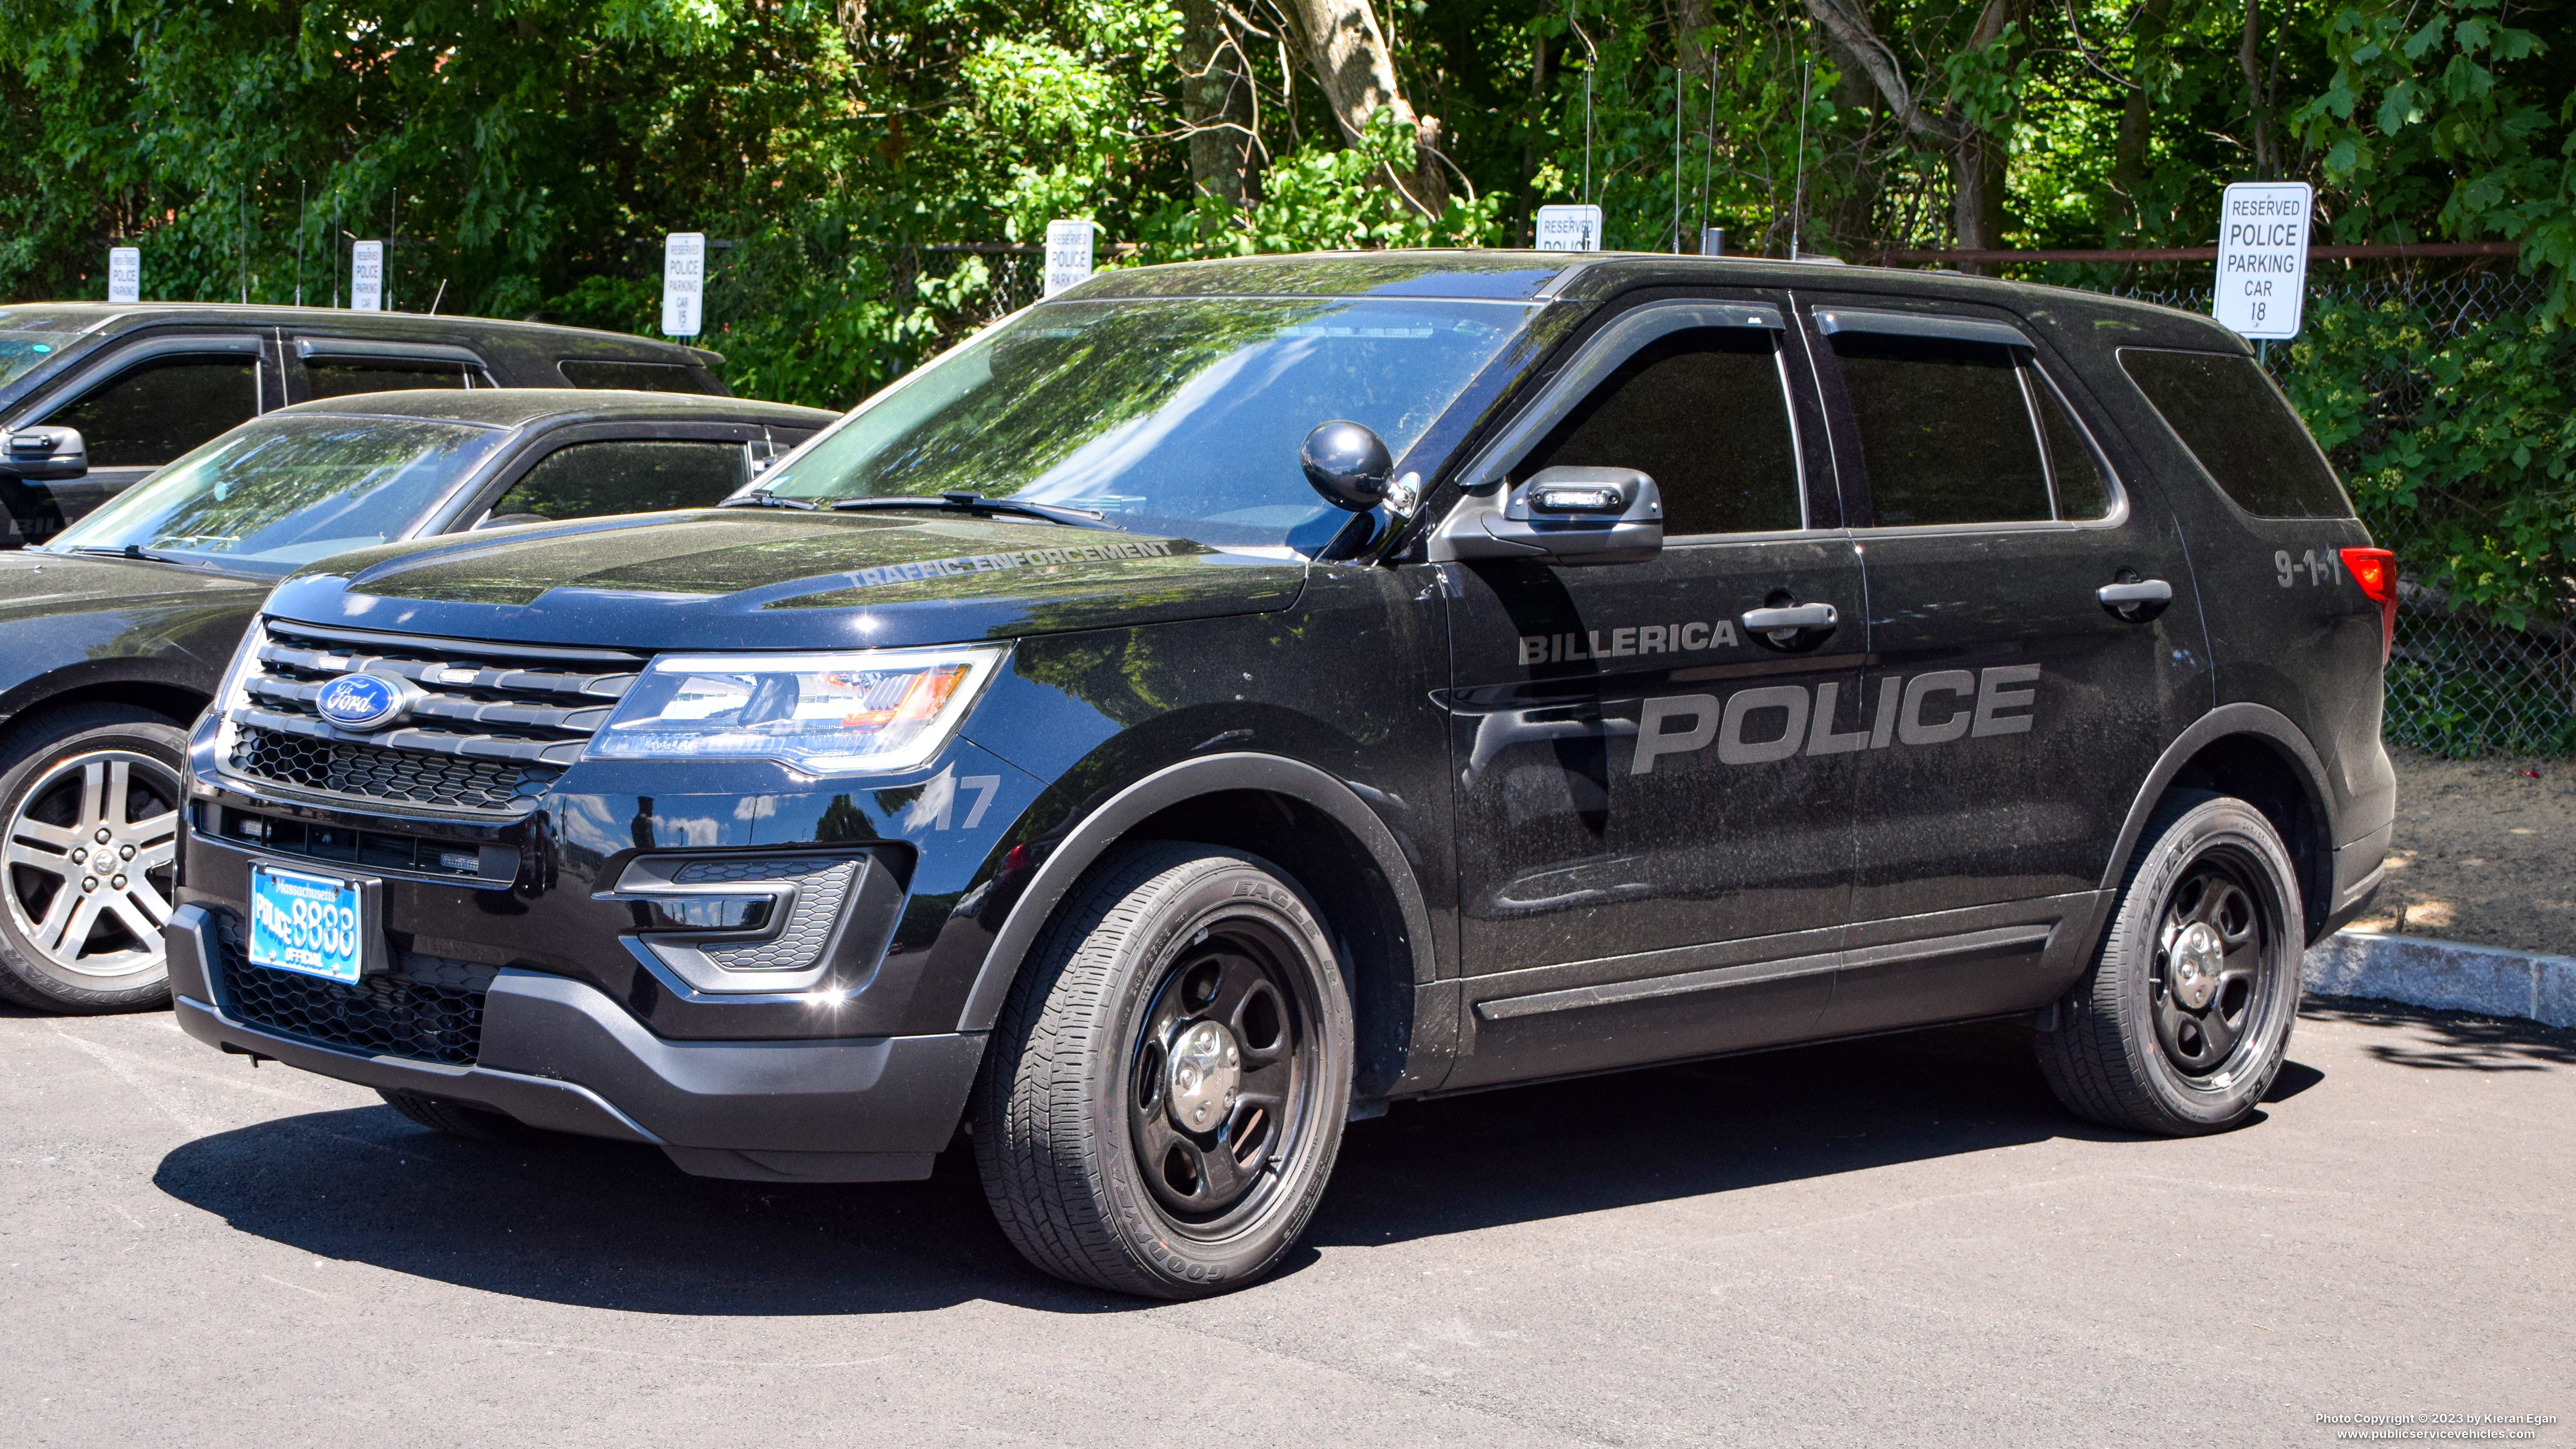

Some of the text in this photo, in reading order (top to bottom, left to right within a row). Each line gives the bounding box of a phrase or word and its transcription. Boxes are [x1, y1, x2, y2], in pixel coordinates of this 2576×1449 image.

[2233, 200, 2300, 216] RESERVED
[1544, 220, 1593, 233] RESERVED
[2230, 224, 2297, 247] POLICE
[1053, 234, 1086, 245] RESERVED
[671, 245, 698, 255] RESERVED
[1052, 251, 1086, 267] POLICE
[356, 265, 378, 278] POLICE
[670, 260, 698, 275] POLICE
[2228, 255, 2294, 273] PARKING
[113, 270, 135, 282] POLICE
[669, 280, 697, 292] PARKING
[2245, 281, 2272, 296] CAR
[676, 297, 688, 308] CAR
[2252, 302, 2266, 321] 18
[679, 311, 686, 324] 15
[843, 541, 1170, 587] TRAFFIC ENFORCEMENT
[2275, 549, 2341, 588] 9-1-1
[1519, 620, 1739, 665] BILLERICA
[327, 681, 377, 712] Ford
[1631, 663, 2041, 775] POLICE
[936, 775, 1000, 830] 17
[276, 877, 336, 902] Massachusetts
[1232, 881, 1320, 939] EAGLE
[256, 893, 354, 957] POLICE 8888
[286, 947, 323, 967] OFFICIAL
[1106, 1118, 1227, 1283] GOODYEAR
